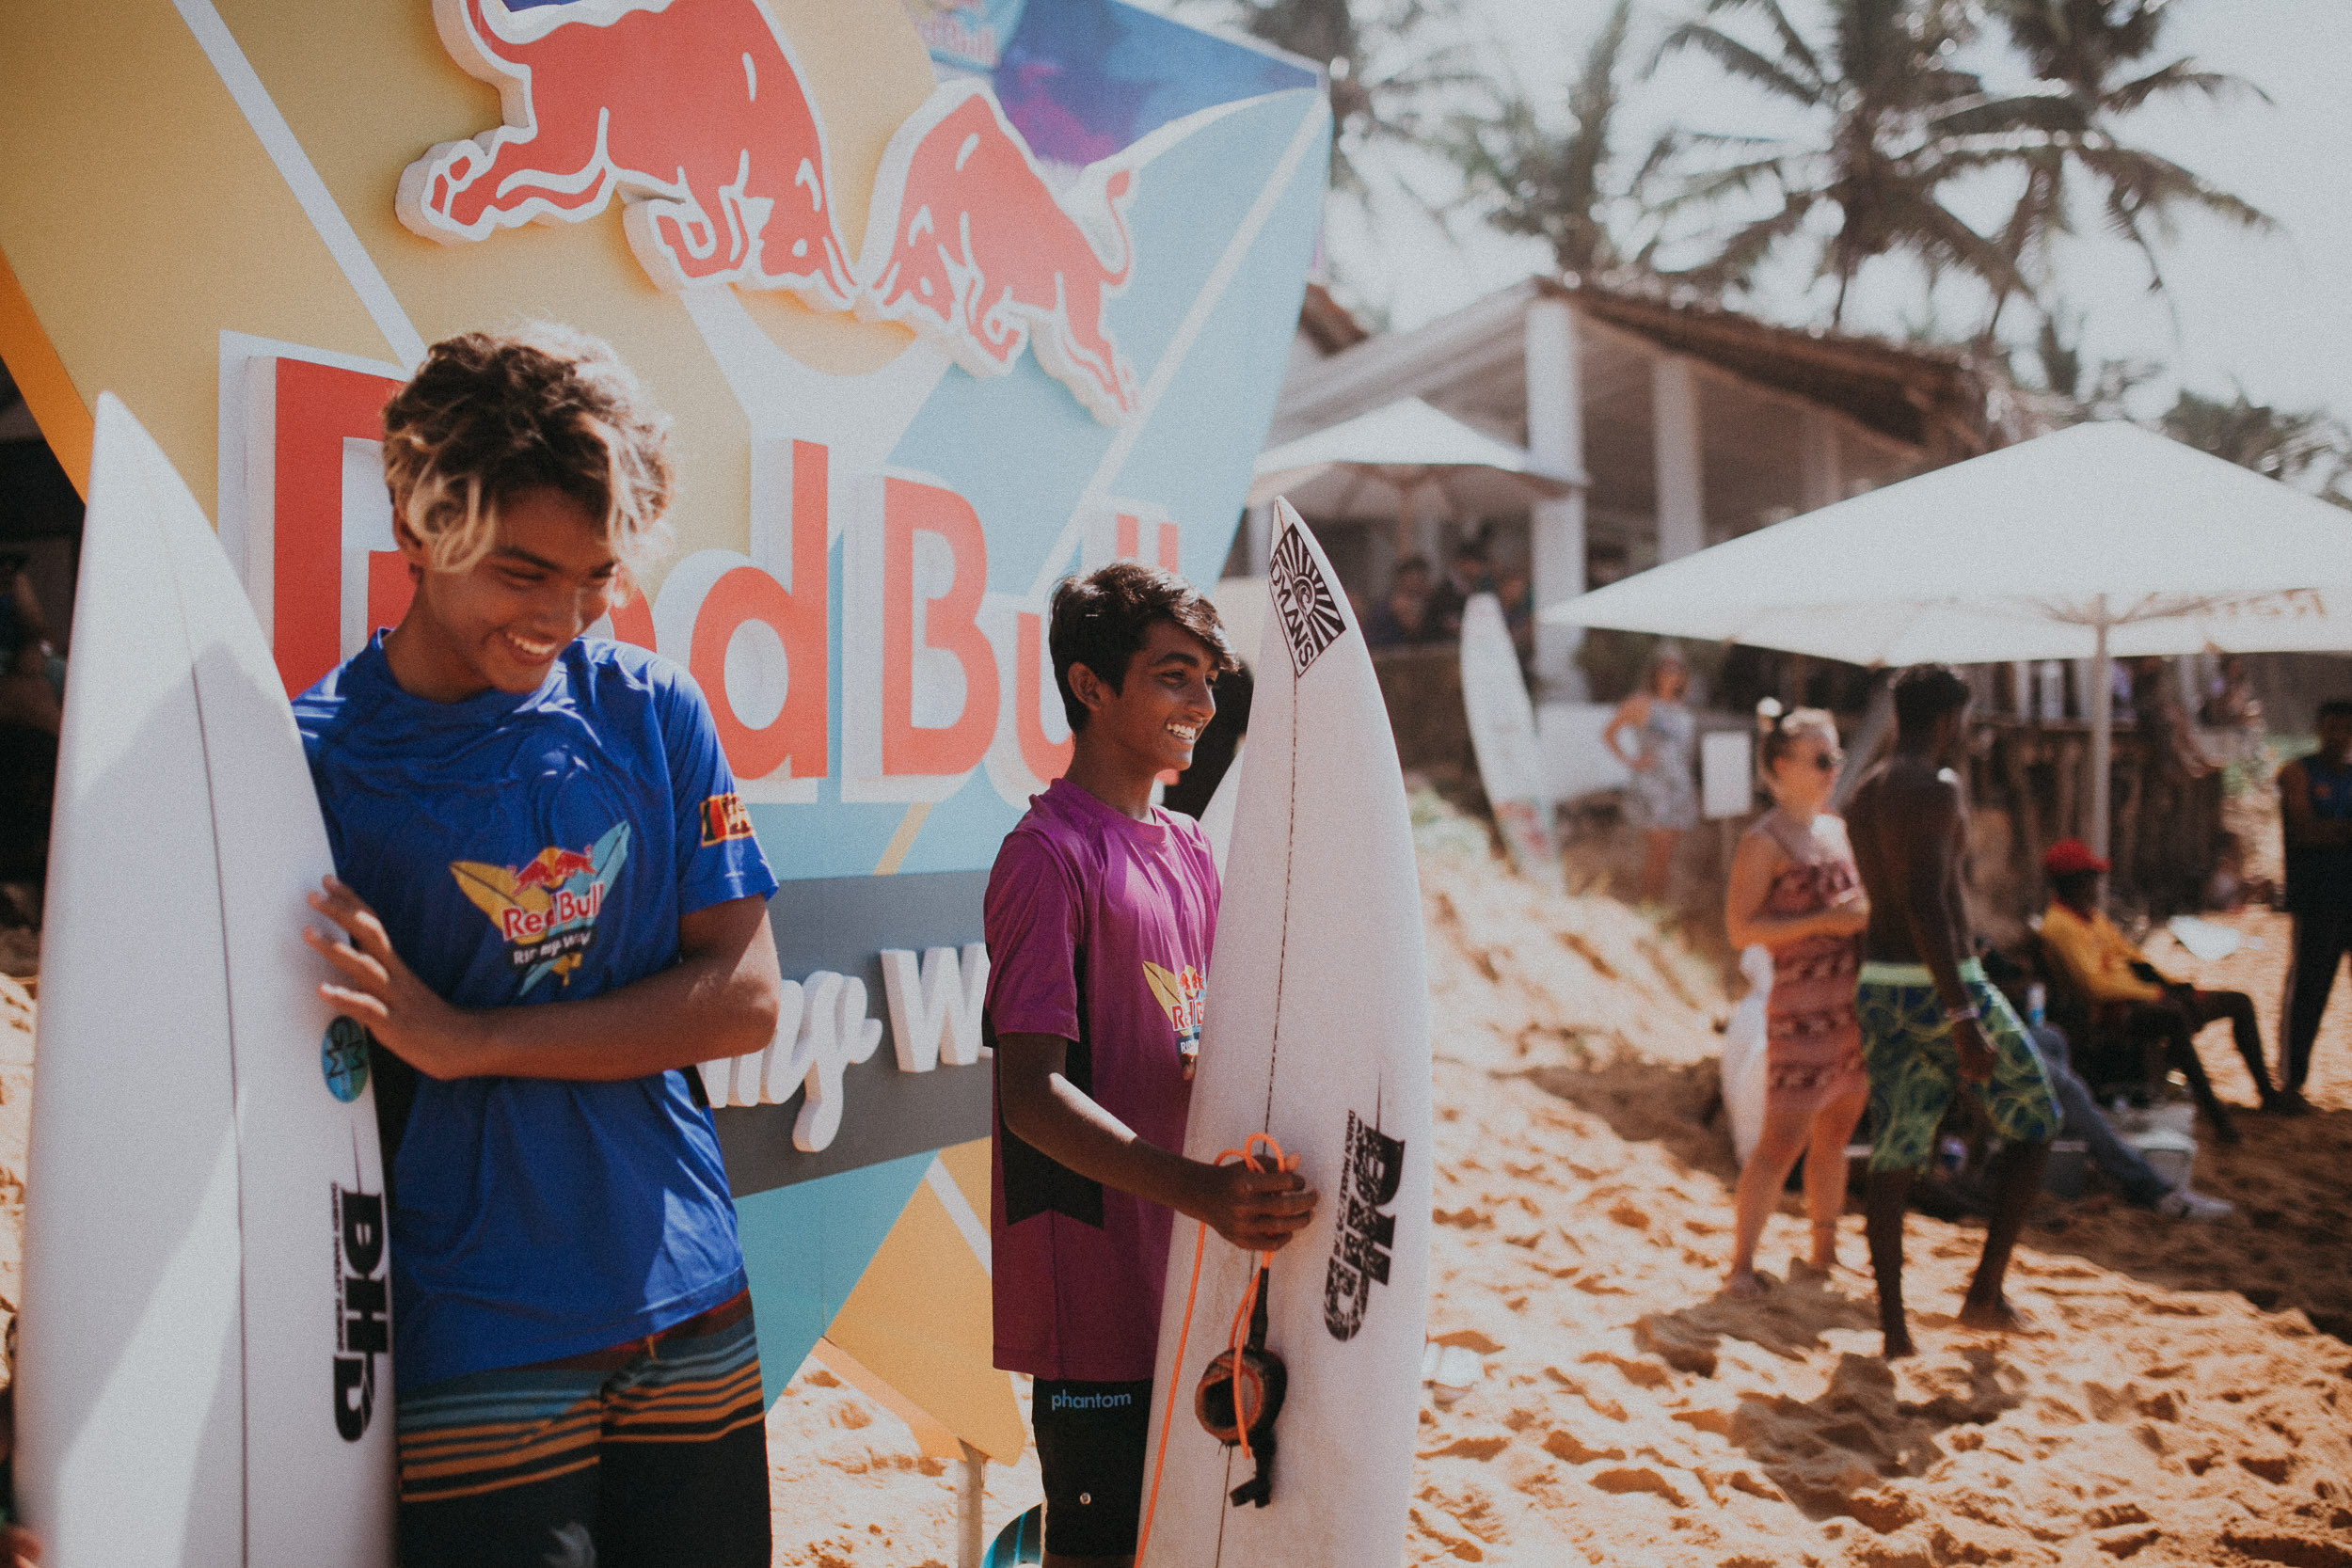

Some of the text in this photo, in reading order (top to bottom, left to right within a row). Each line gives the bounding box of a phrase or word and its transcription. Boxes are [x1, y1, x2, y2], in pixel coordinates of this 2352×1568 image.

[273, 356, 830, 782] Rd
[557, 881, 604, 923] Bull
[333, 1187, 389, 1443] DHD
[1324, 1116, 1406, 1343] DHD
[1051, 1387, 1132, 1411] phantom
